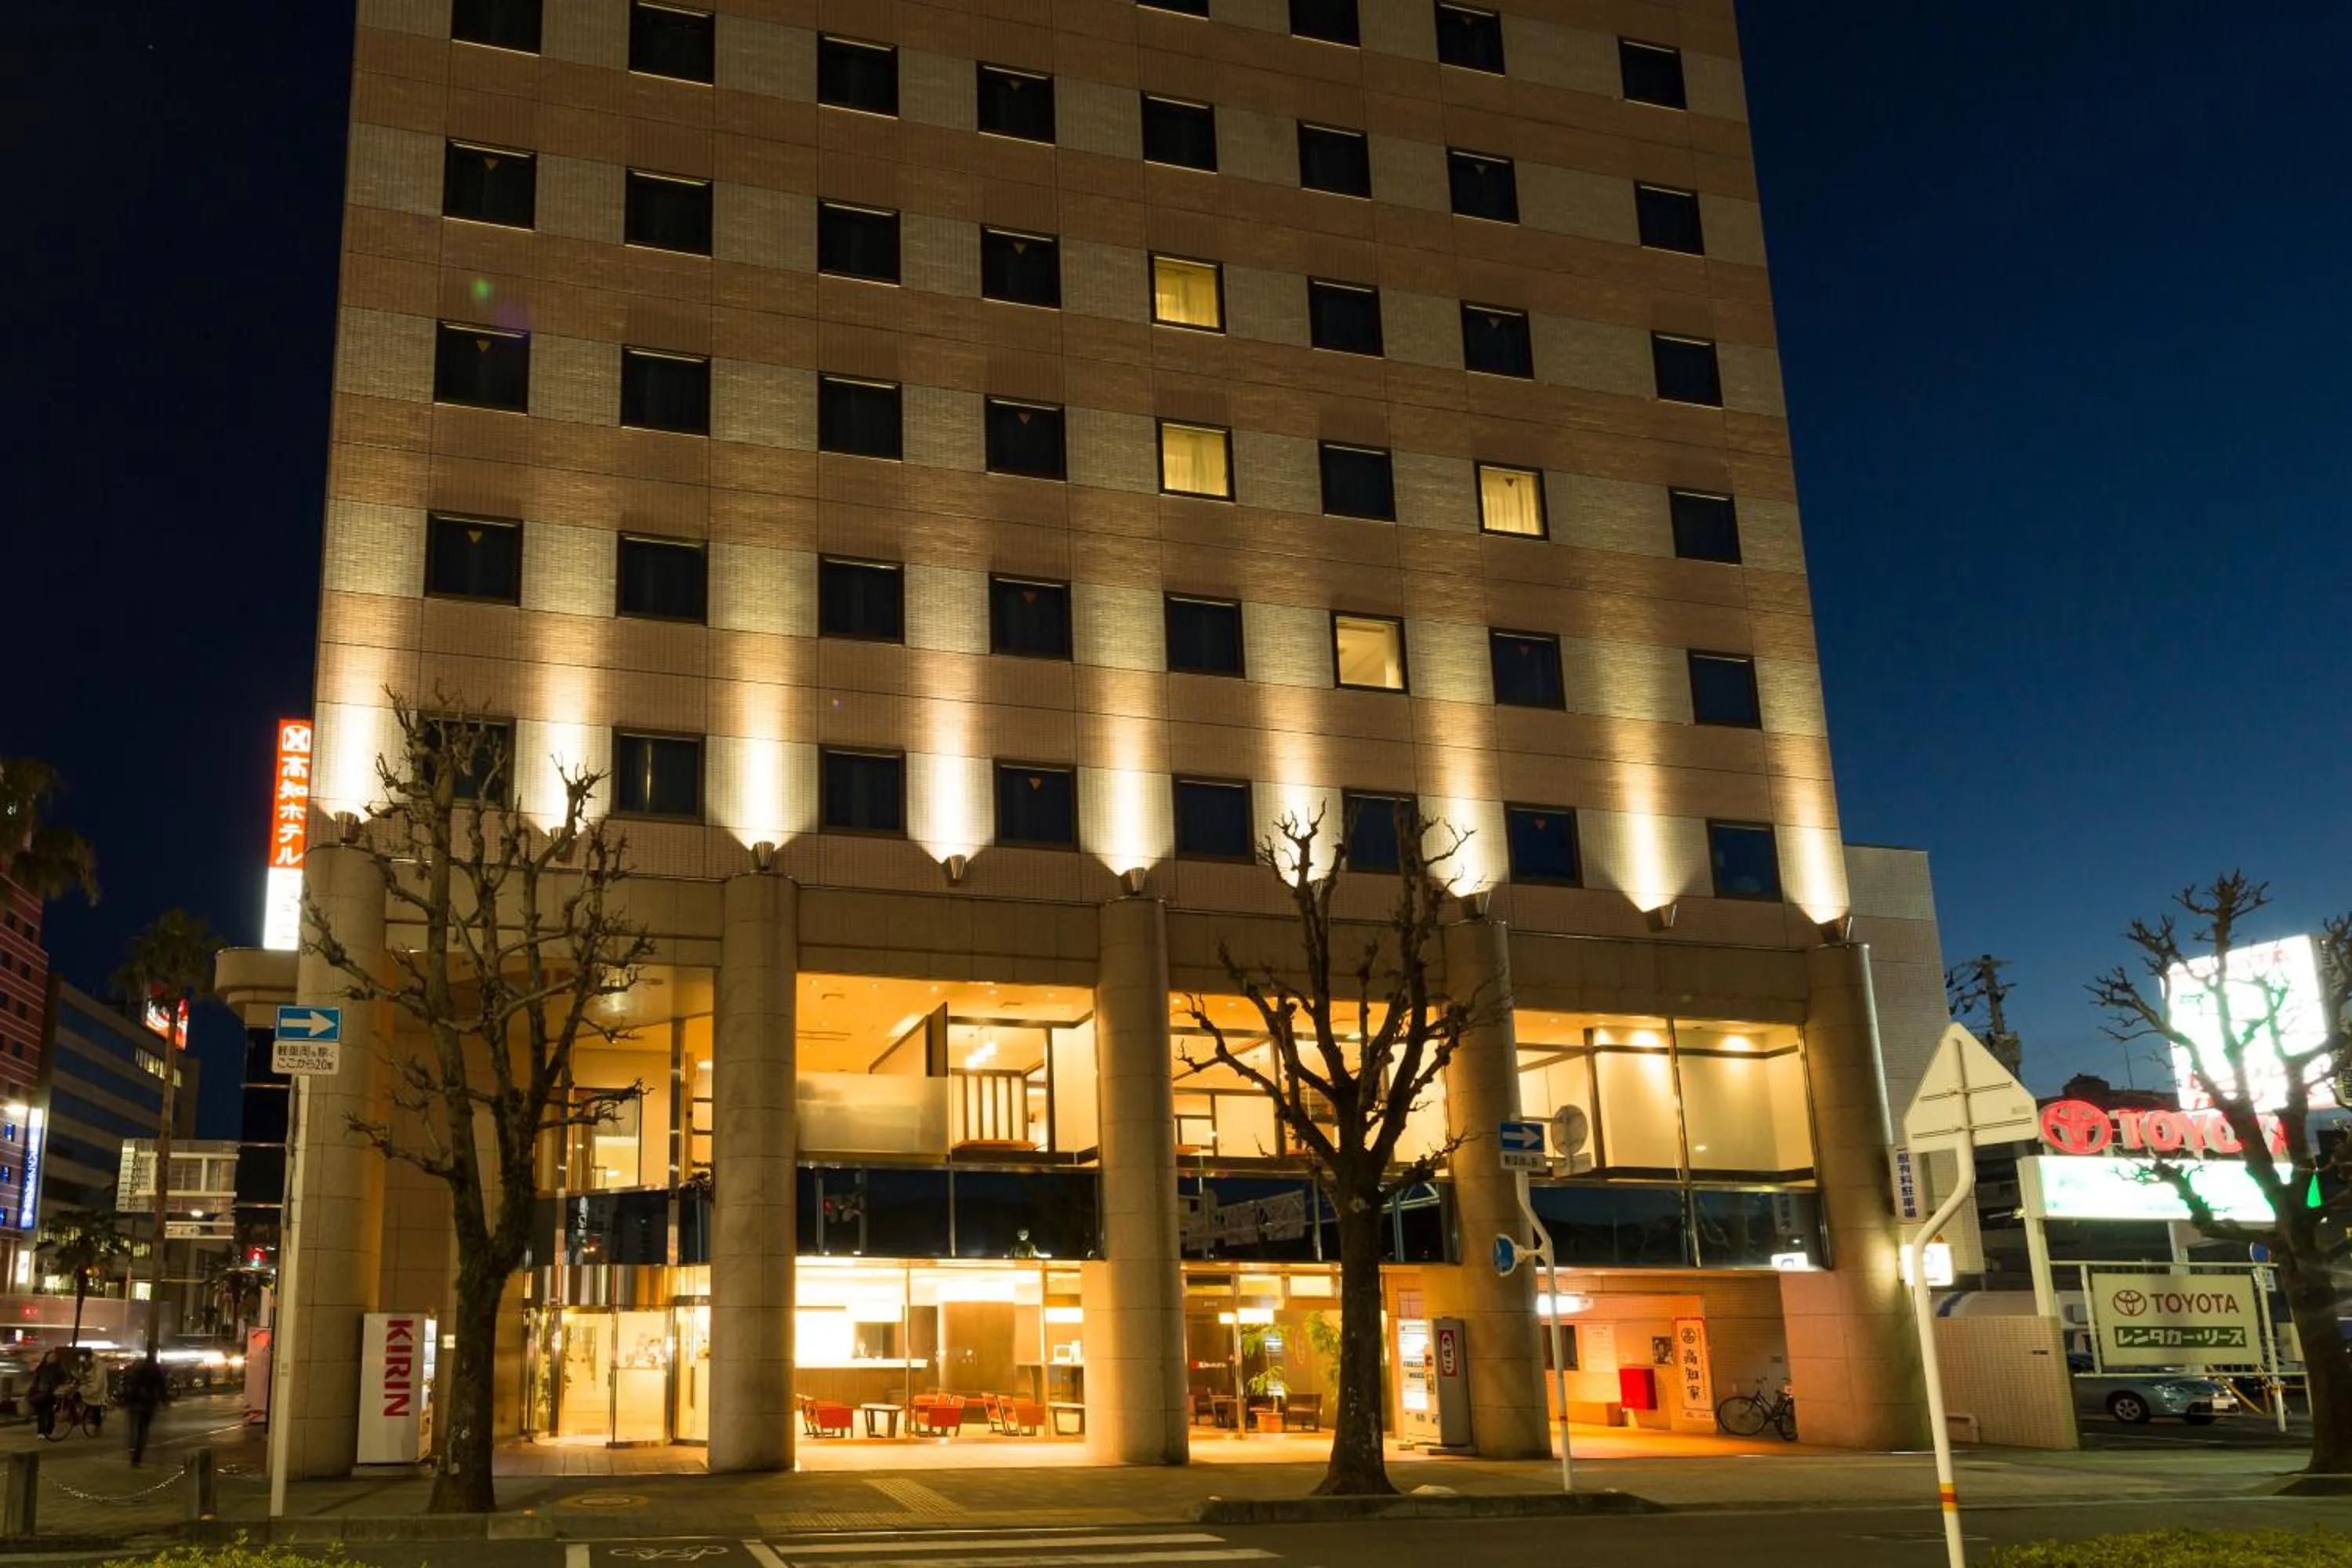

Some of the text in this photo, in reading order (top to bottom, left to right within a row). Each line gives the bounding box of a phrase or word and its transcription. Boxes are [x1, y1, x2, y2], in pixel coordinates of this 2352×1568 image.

[277, 755, 309, 866] 高知ホテル
[2150, 1293, 2240, 1314] TOYOTA
[2117, 1329, 2245, 1345] レンタカー・リース
[383, 1319, 414, 1417] KIRIN
[1683, 1348, 1700, 1401] 高知家
